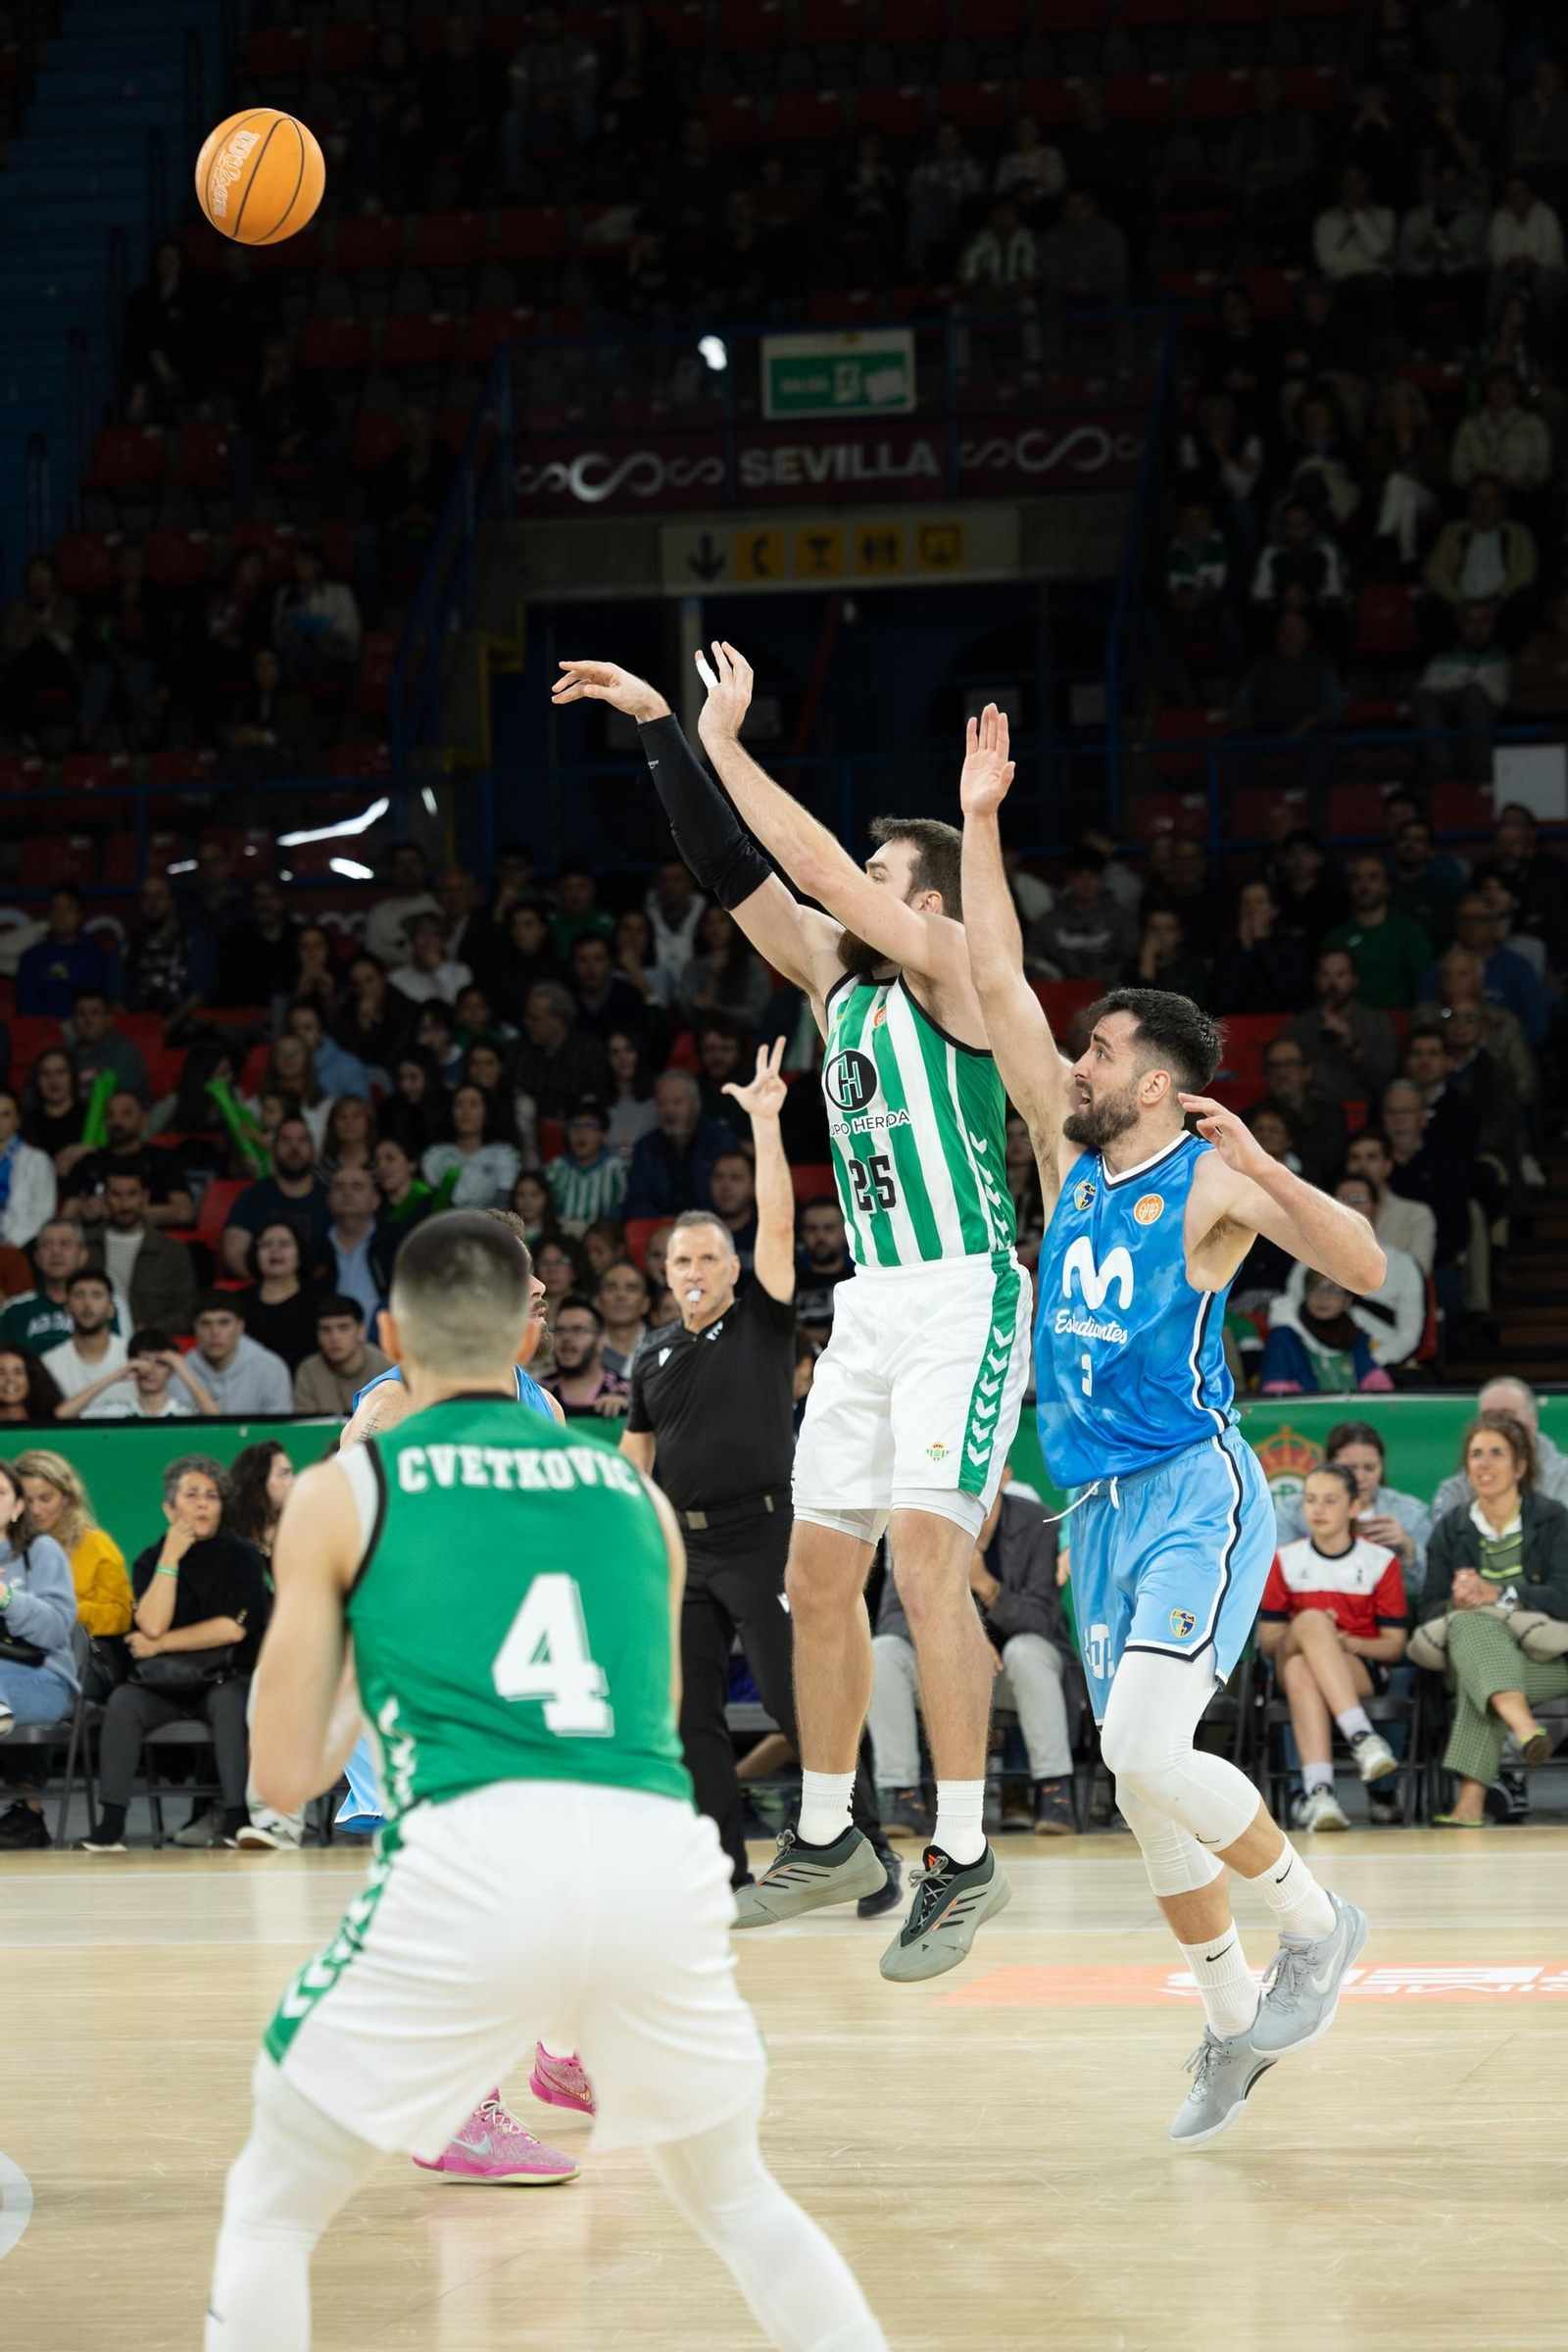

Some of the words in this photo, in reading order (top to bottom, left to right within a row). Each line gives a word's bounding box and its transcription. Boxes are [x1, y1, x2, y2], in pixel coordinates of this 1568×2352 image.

[741, 441, 938, 485] SEVILLA
[848, 1154, 898, 1212] 25
[1081, 1353, 1093, 1397] 3
[492, 1572, 614, 1739] 4
